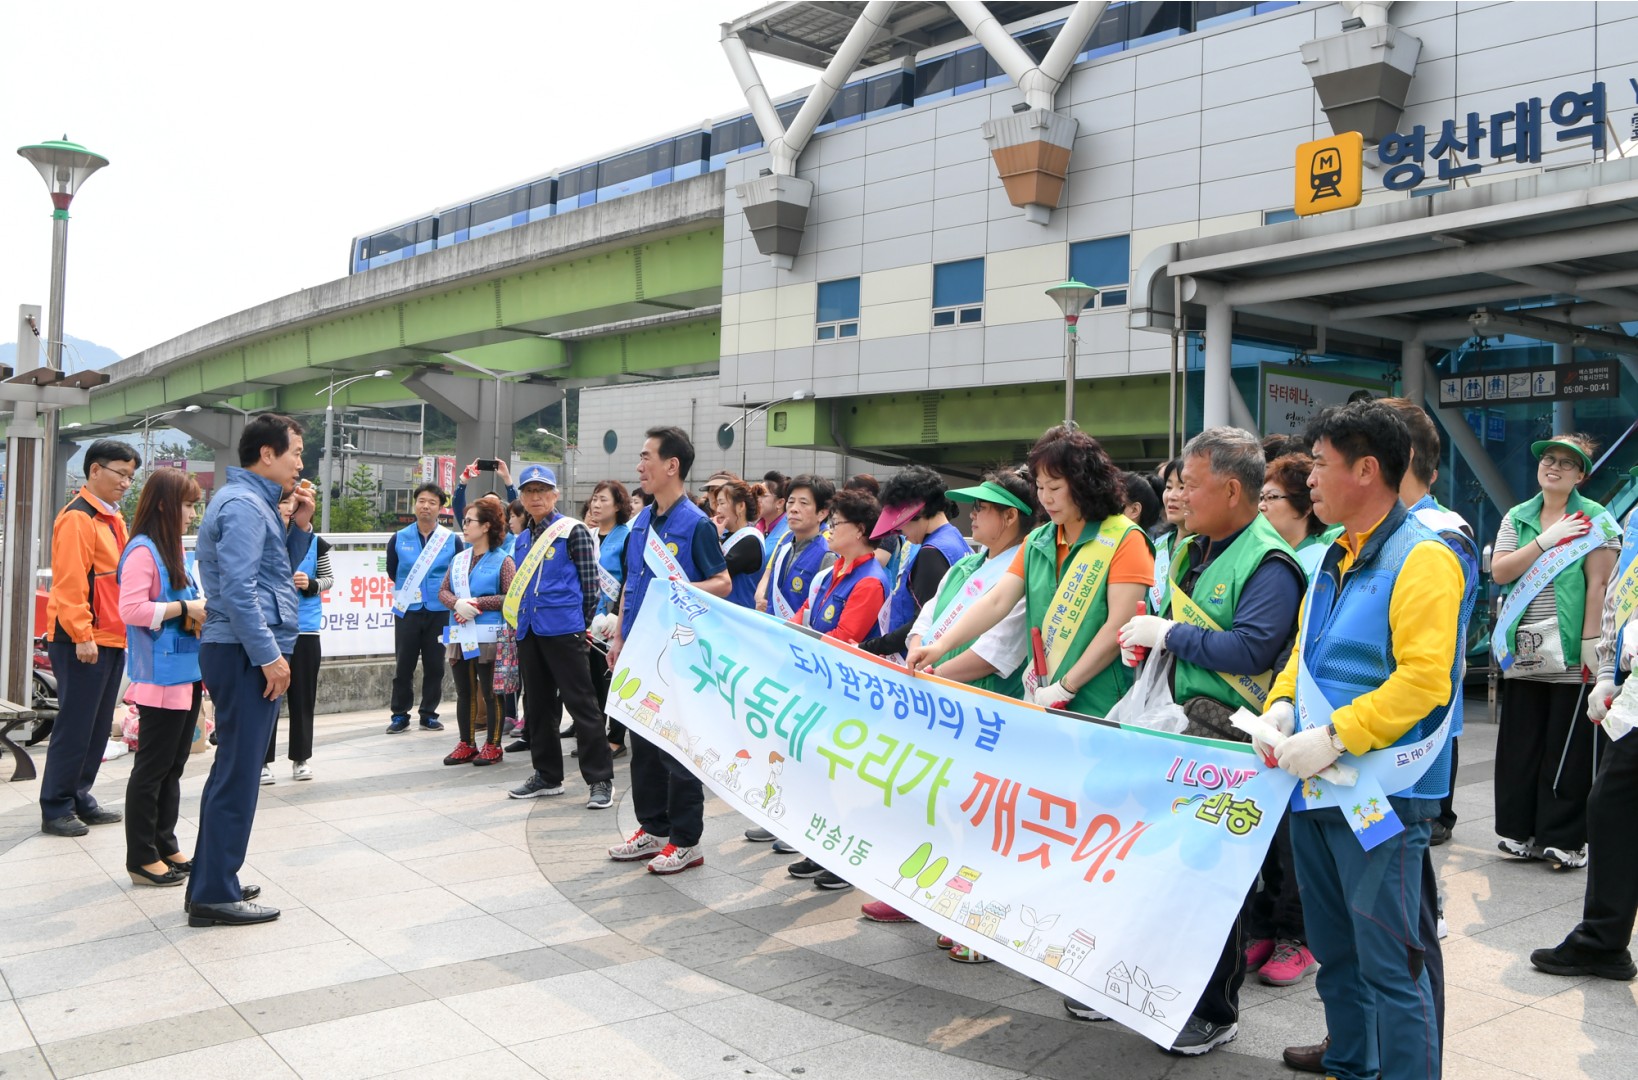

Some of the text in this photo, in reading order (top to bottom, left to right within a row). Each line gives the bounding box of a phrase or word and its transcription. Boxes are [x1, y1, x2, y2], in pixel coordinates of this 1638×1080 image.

[1377, 81, 1608, 191] 영산대역
[1563, 383, 1610, 394] 05:00~00:41
[1059, 559, 1104, 641] 환경정비의 날
[1062, 562, 1088, 604] 세계인이
[1051, 604, 1068, 625] 찾는
[788, 641, 1007, 752] 도시 환경정비의 날
[688, 638, 1150, 884] 우리 동네 우리가 깨끗이!
[1166, 756, 1183, 782] I
[1195, 791, 1265, 836] 반송
[803, 811, 874, 867] 반송1동
